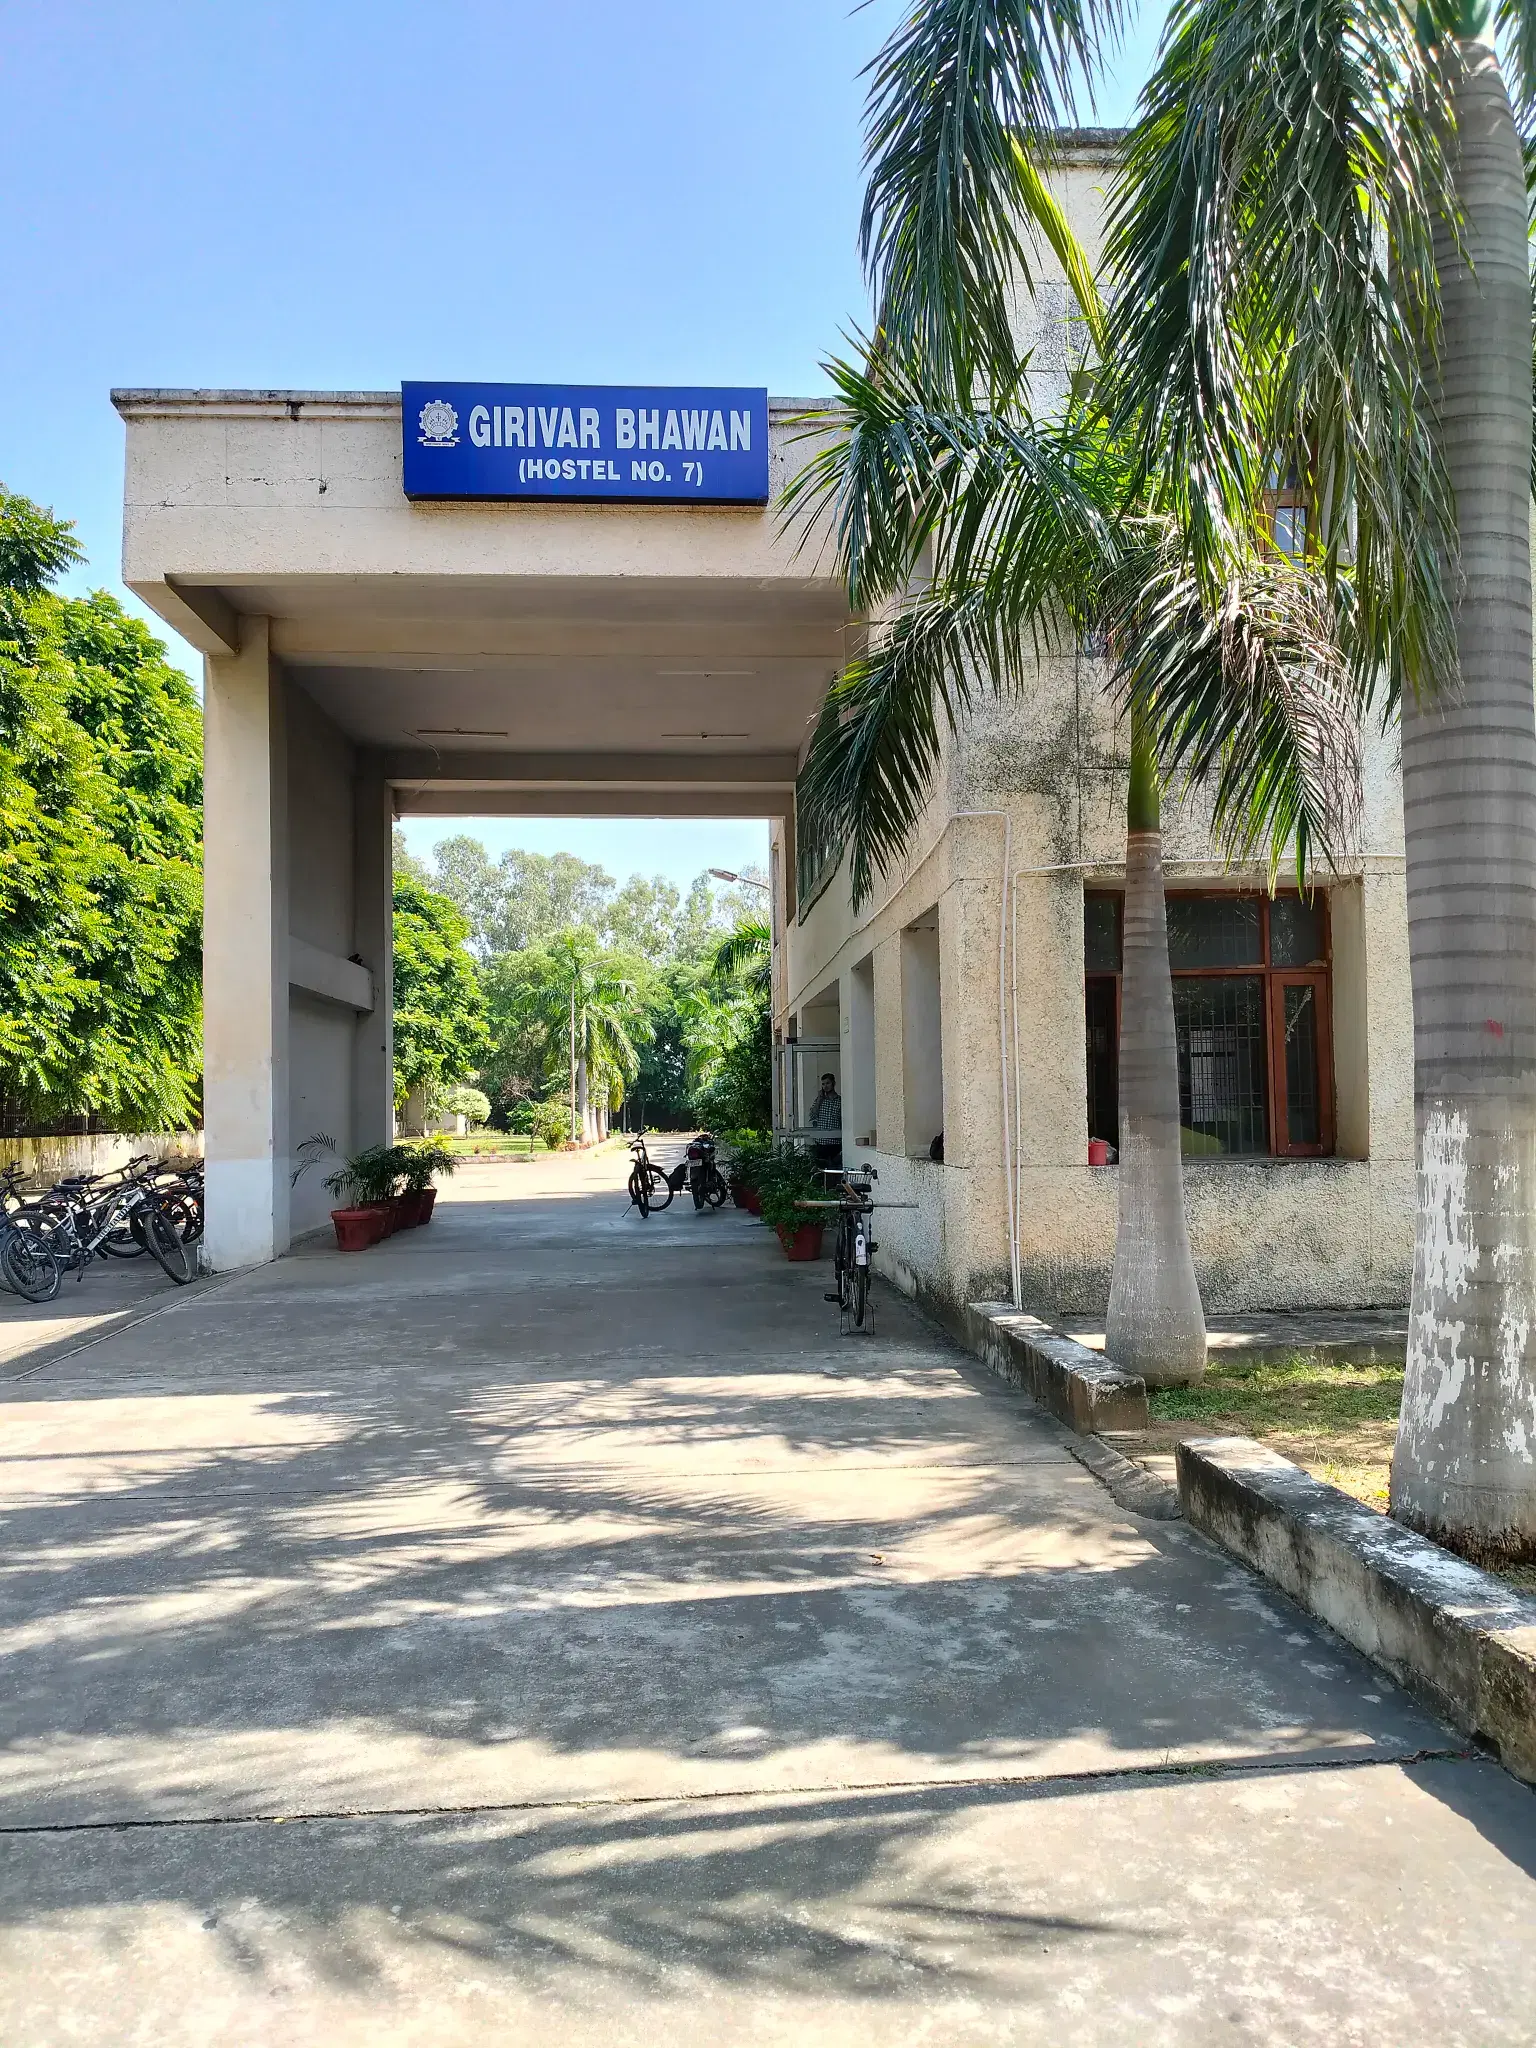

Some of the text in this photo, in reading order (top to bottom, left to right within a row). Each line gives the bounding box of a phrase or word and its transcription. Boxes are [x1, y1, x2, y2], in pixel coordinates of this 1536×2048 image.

[469, 405, 600, 448] GIRIVAR
[616, 409, 751, 451] BHAWAN
[518, 459, 703, 487] (HOSTEL NO. 7)
